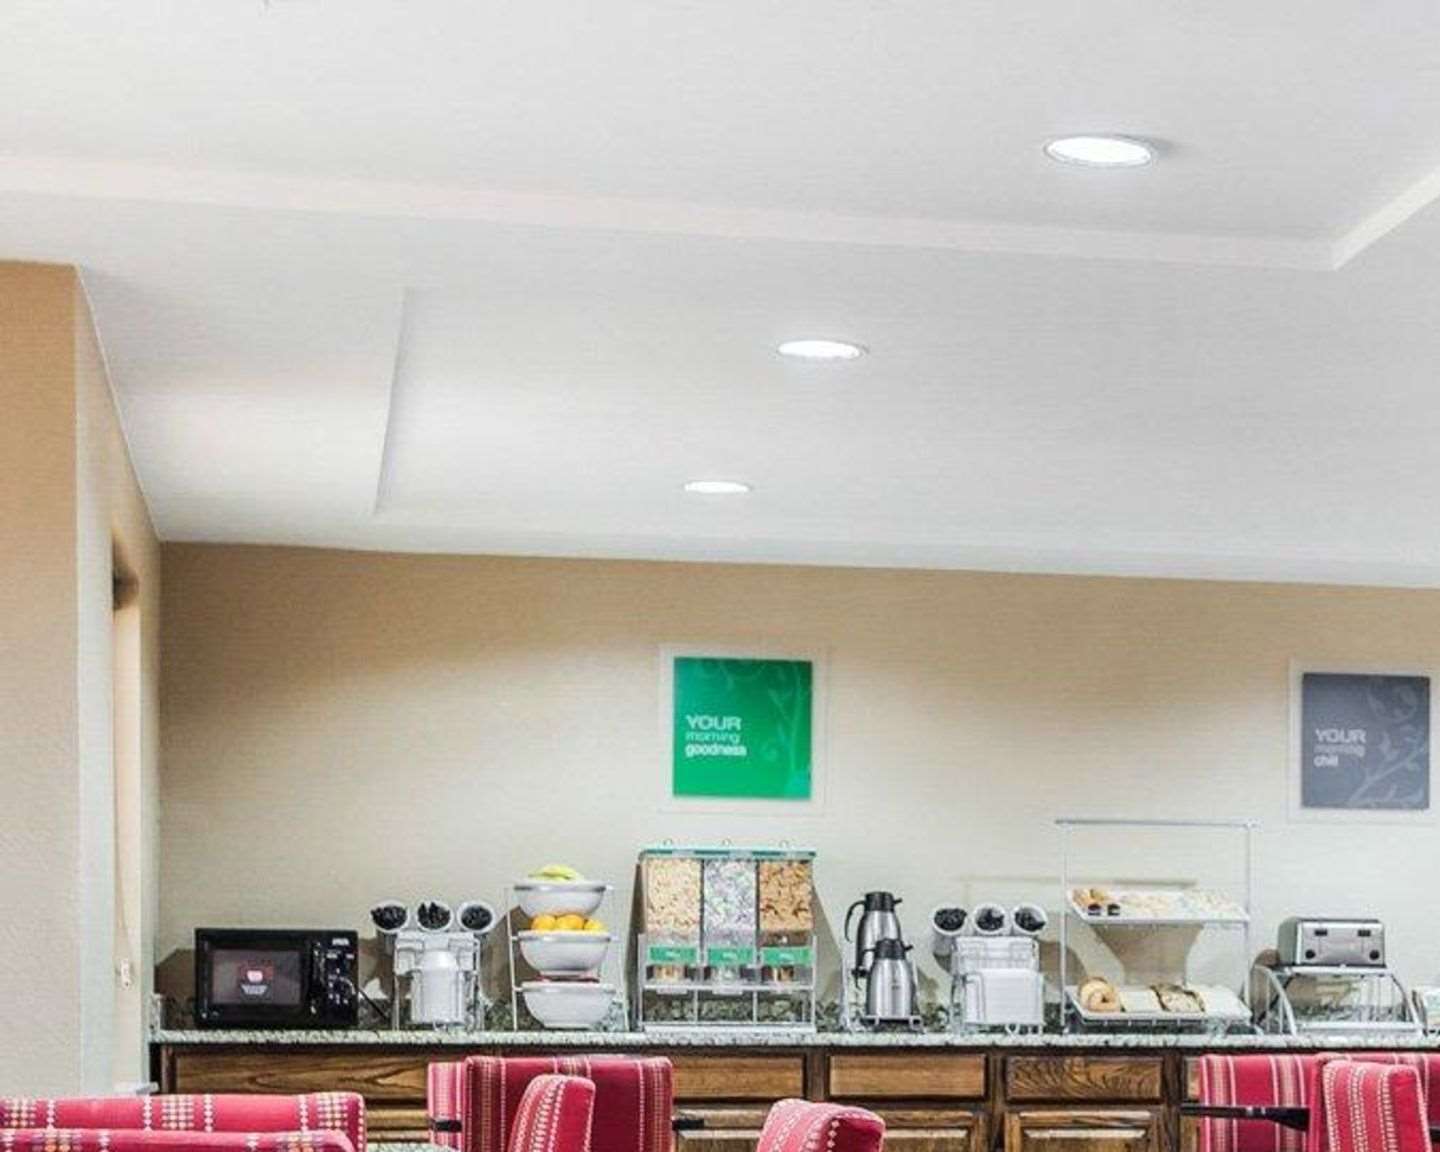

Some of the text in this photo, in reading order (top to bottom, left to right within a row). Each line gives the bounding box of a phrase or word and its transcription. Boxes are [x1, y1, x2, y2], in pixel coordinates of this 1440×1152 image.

[686, 715, 742, 731] YOUR
[685, 732, 740, 744] morning
[1315, 728, 1367, 743] YOUR
[685, 743, 747, 757] goodness
